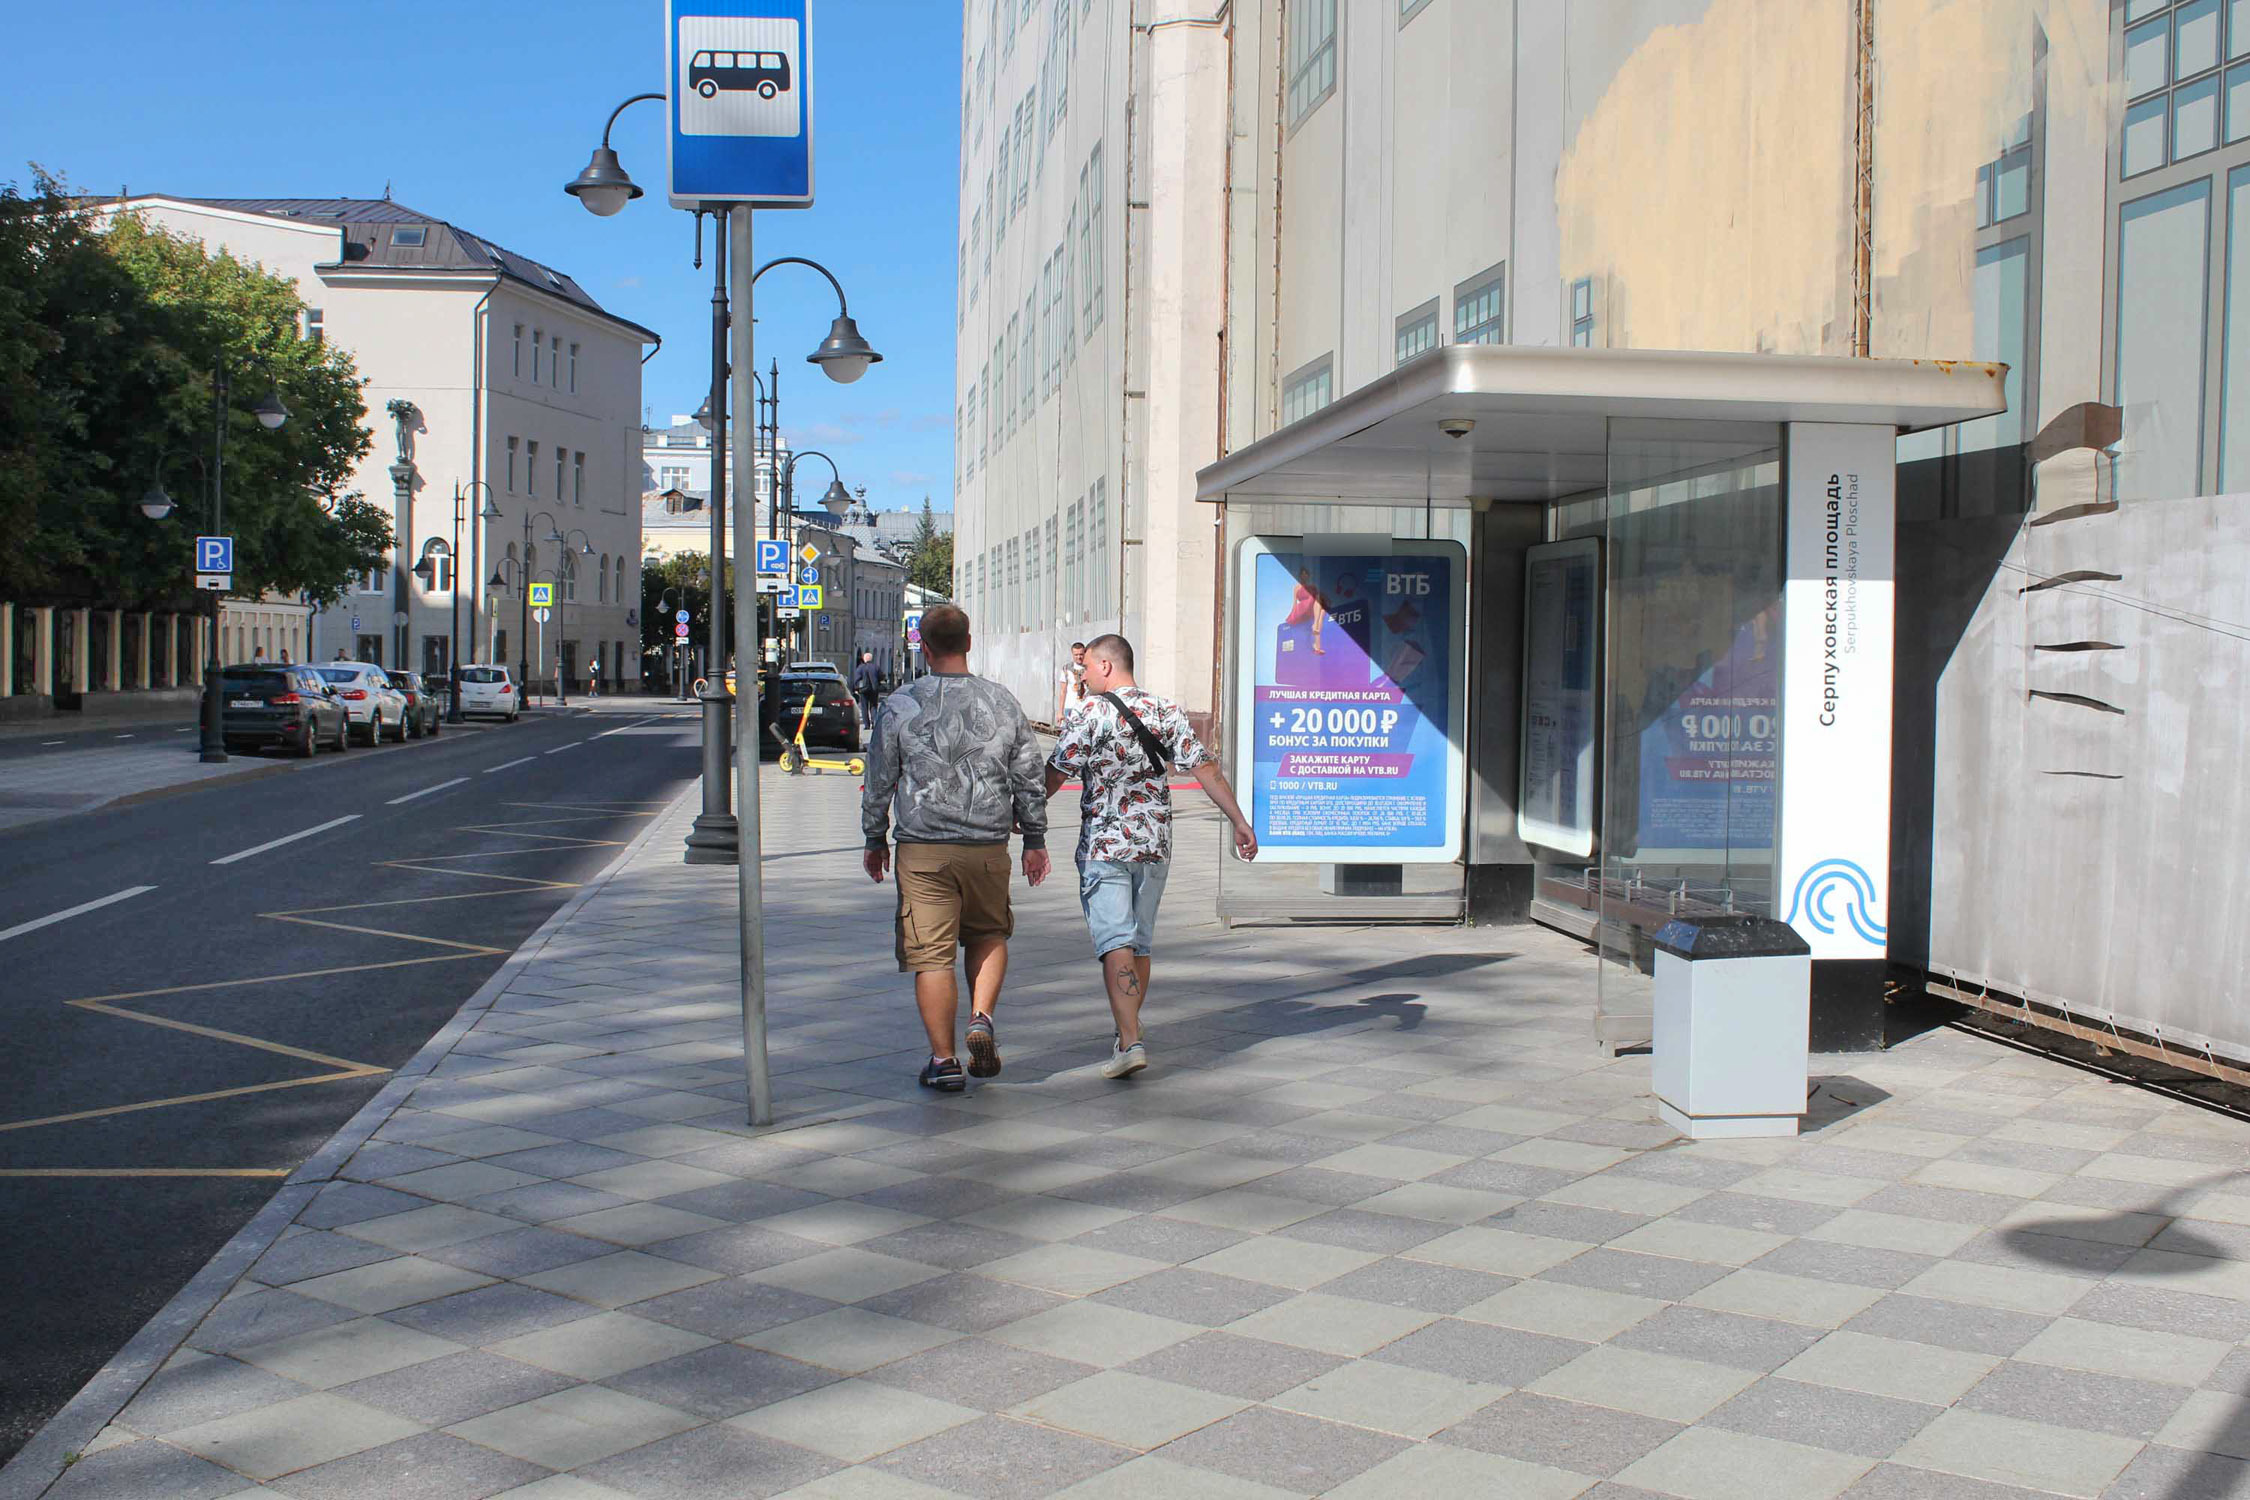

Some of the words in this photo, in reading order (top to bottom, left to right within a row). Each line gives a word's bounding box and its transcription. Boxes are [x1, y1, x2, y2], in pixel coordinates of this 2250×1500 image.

[1845, 474, 1858, 536] Ploschad
[1826, 473, 1842, 569] площадь
[205, 541, 224, 568] P
[762, 544, 780, 569] P
[1386, 573, 1431, 595] ВТБ
[1844, 541, 1860, 654] Serpukhovskaya
[1338, 609, 1362, 625] ВТБ
[1819, 576, 1840, 727] Серпуховская
[1268, 690, 1307, 699] ЛУЧШАЯ
[1309, 690, 1360, 701] КРЕДИТНАЯ
[1362, 691, 1391, 700] КАРТА
[1290, 708, 1323, 733] 20
[1327, 708, 1377, 734] 000
[1269, 735, 1309, 747] БОНУС
[1311, 735, 1328, 747] ЗА
[1330, 736, 1389, 748] ПОКУПКИ
[1289, 755, 1339, 764] ЗАКАЖИТЕ
[1341, 756, 1371, 764] КАРТУ
[1289, 765, 1297, 774] С
[1297, 765, 1351, 776] ДОСТАВКОЙ
[1353, 766, 1365, 775] НА
[1367, 766, 1399, 775] VTB.RU
[1278, 781, 1300, 790] 1000
[1307, 781, 1338, 791] VTB.RU
